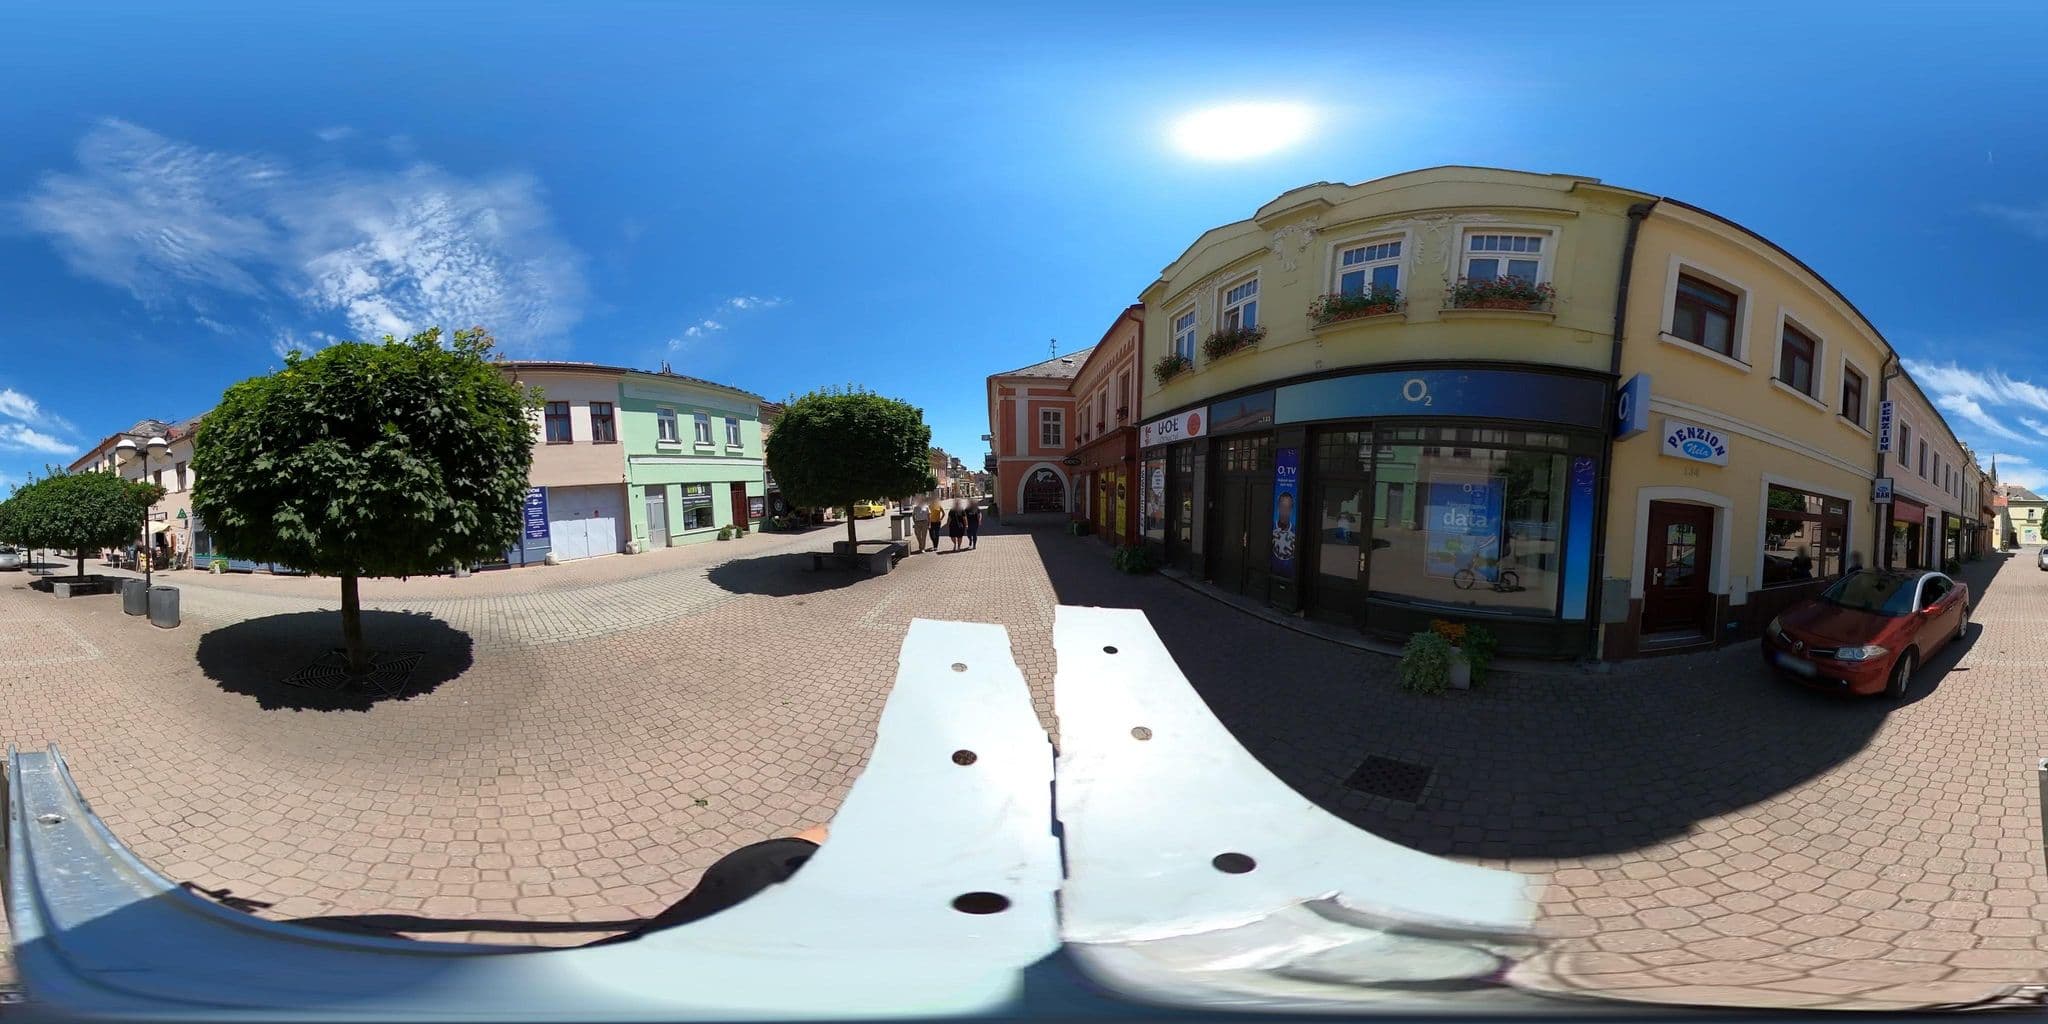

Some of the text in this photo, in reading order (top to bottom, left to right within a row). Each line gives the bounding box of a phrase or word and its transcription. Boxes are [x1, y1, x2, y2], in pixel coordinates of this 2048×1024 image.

[1403, 379, 1432, 406] O2
[1880, 402, 1891, 451] PENZION
[1668, 427, 1725, 456] PENZION
[1286, 466, 1297, 475] TV
[1443, 508, 1488, 527] data
